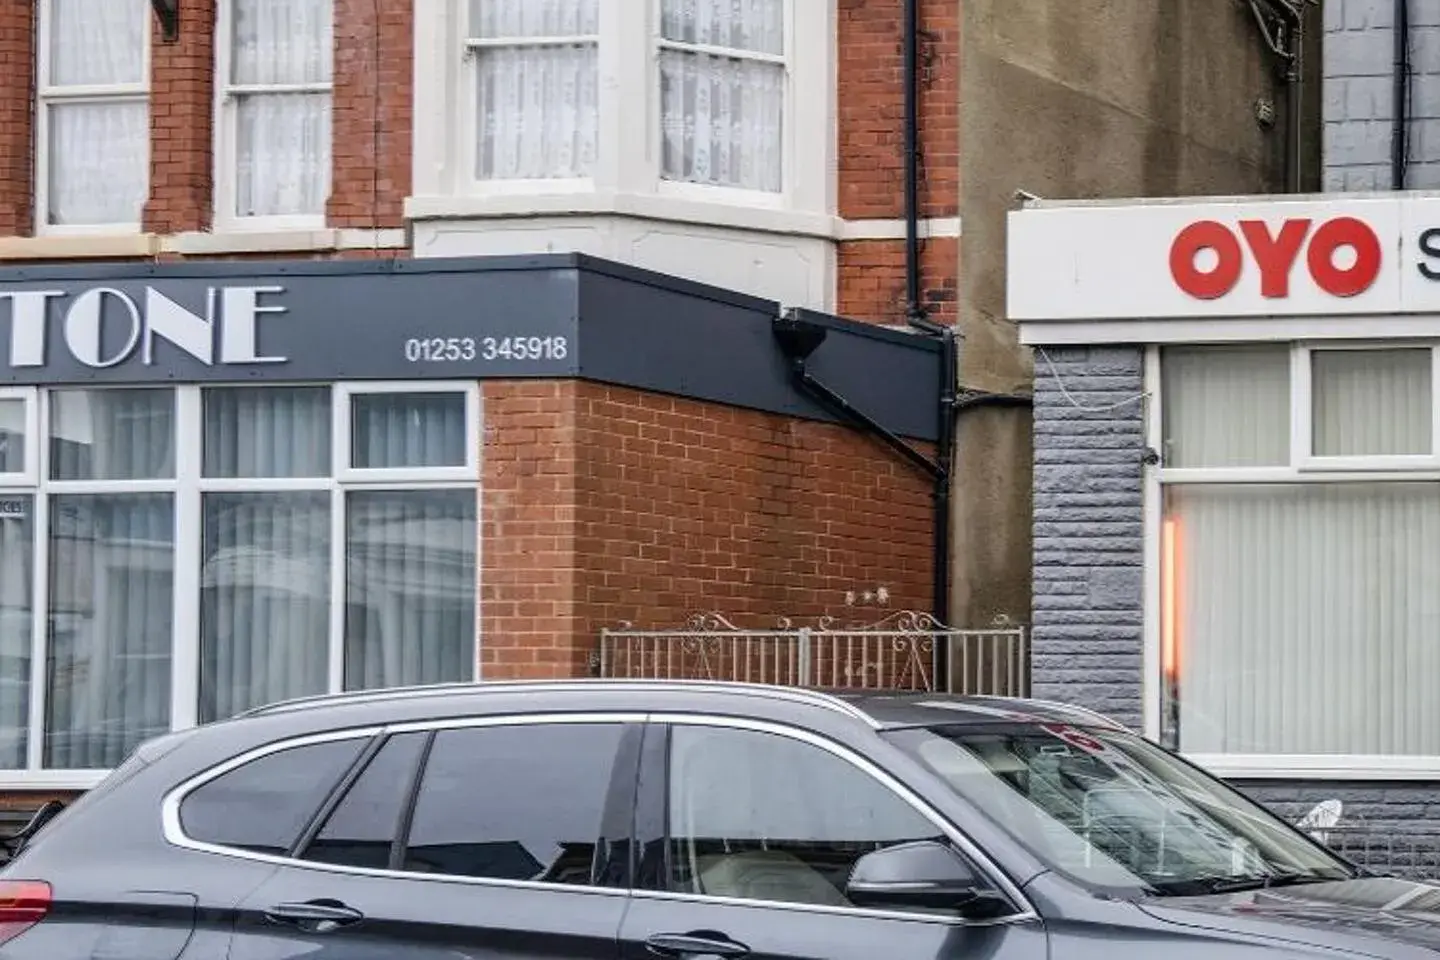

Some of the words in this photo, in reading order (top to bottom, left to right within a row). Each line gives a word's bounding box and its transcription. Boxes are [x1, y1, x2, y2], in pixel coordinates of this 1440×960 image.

[1169, 216, 1382, 300] OYO
[404, 338, 476, 362] 01253
[482, 336, 568, 361] 345918
